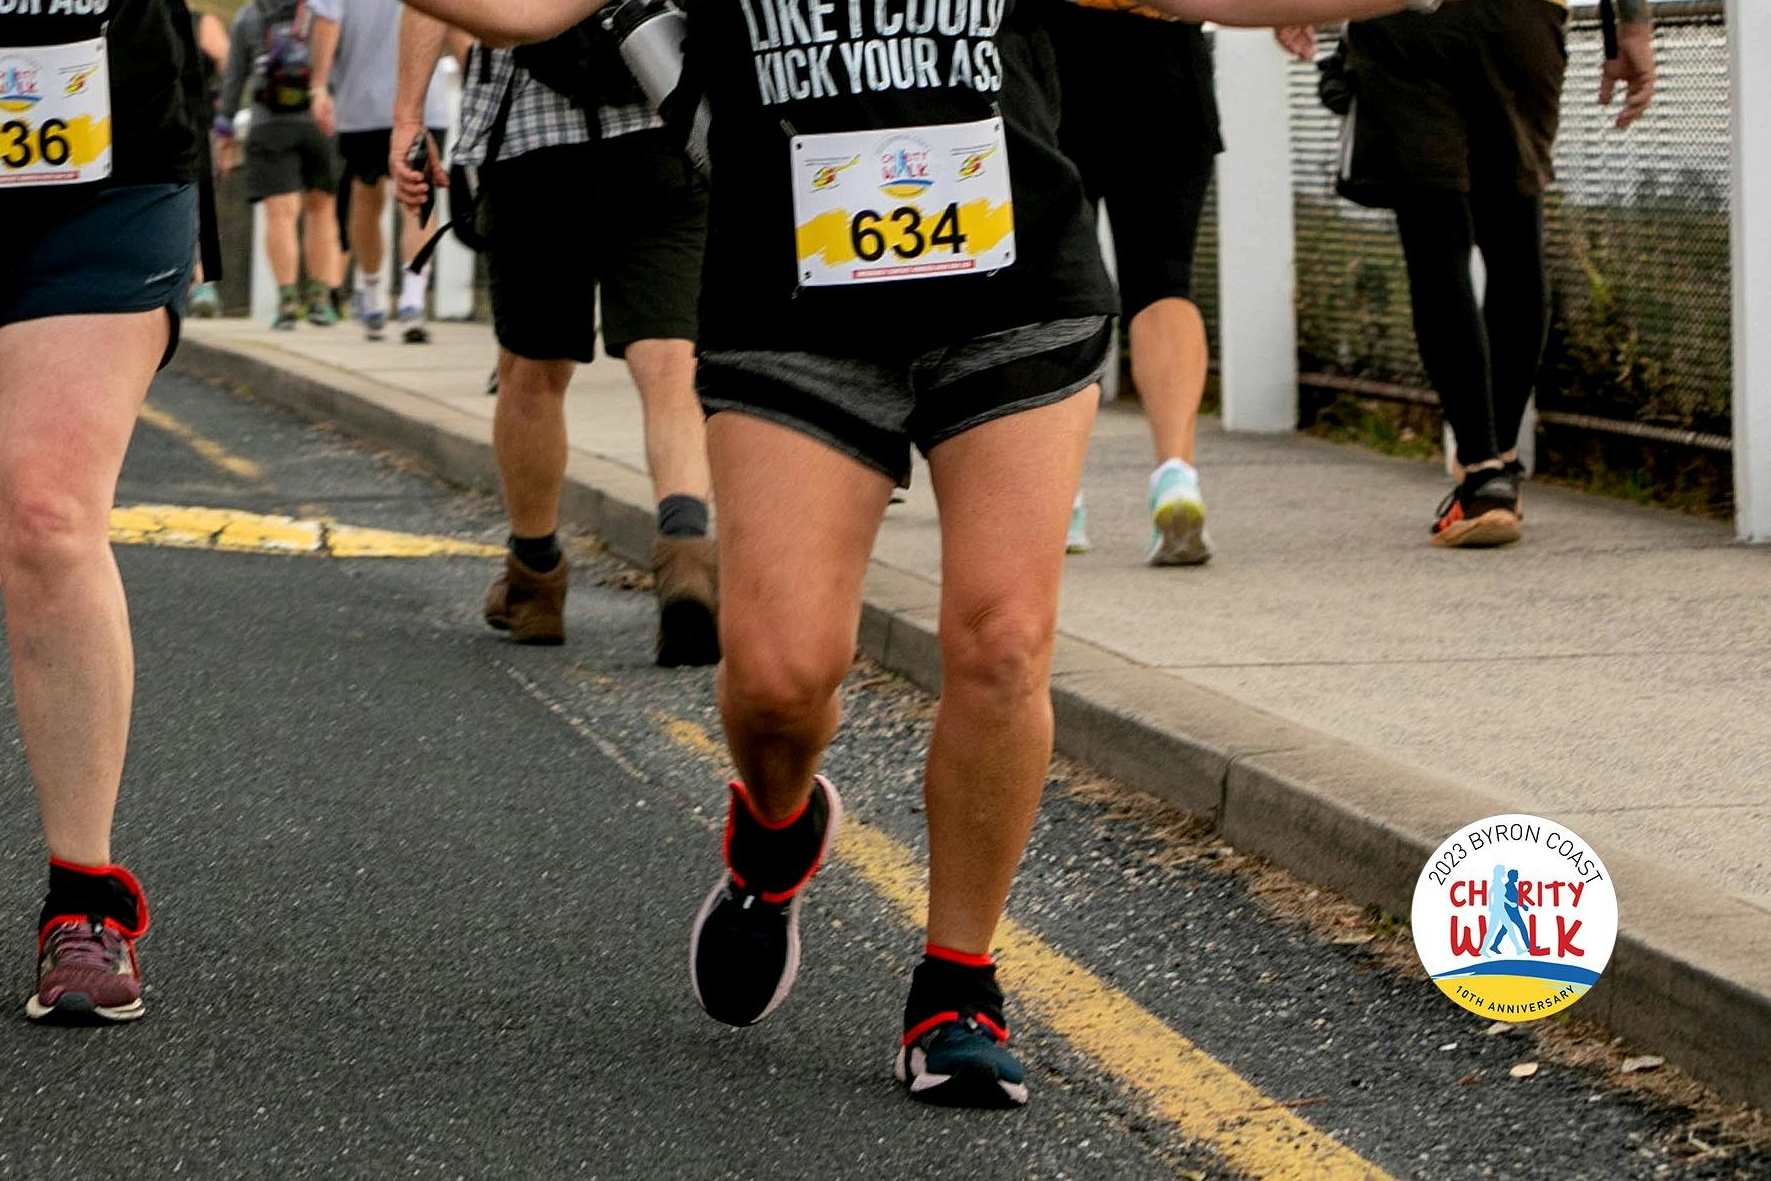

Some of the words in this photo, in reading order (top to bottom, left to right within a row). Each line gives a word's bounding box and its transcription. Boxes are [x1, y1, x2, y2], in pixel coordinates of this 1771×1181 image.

[754, 43, 840, 107] KICK
[839, 37, 942, 96] YOUR
[850, 201, 968, 263] 634
